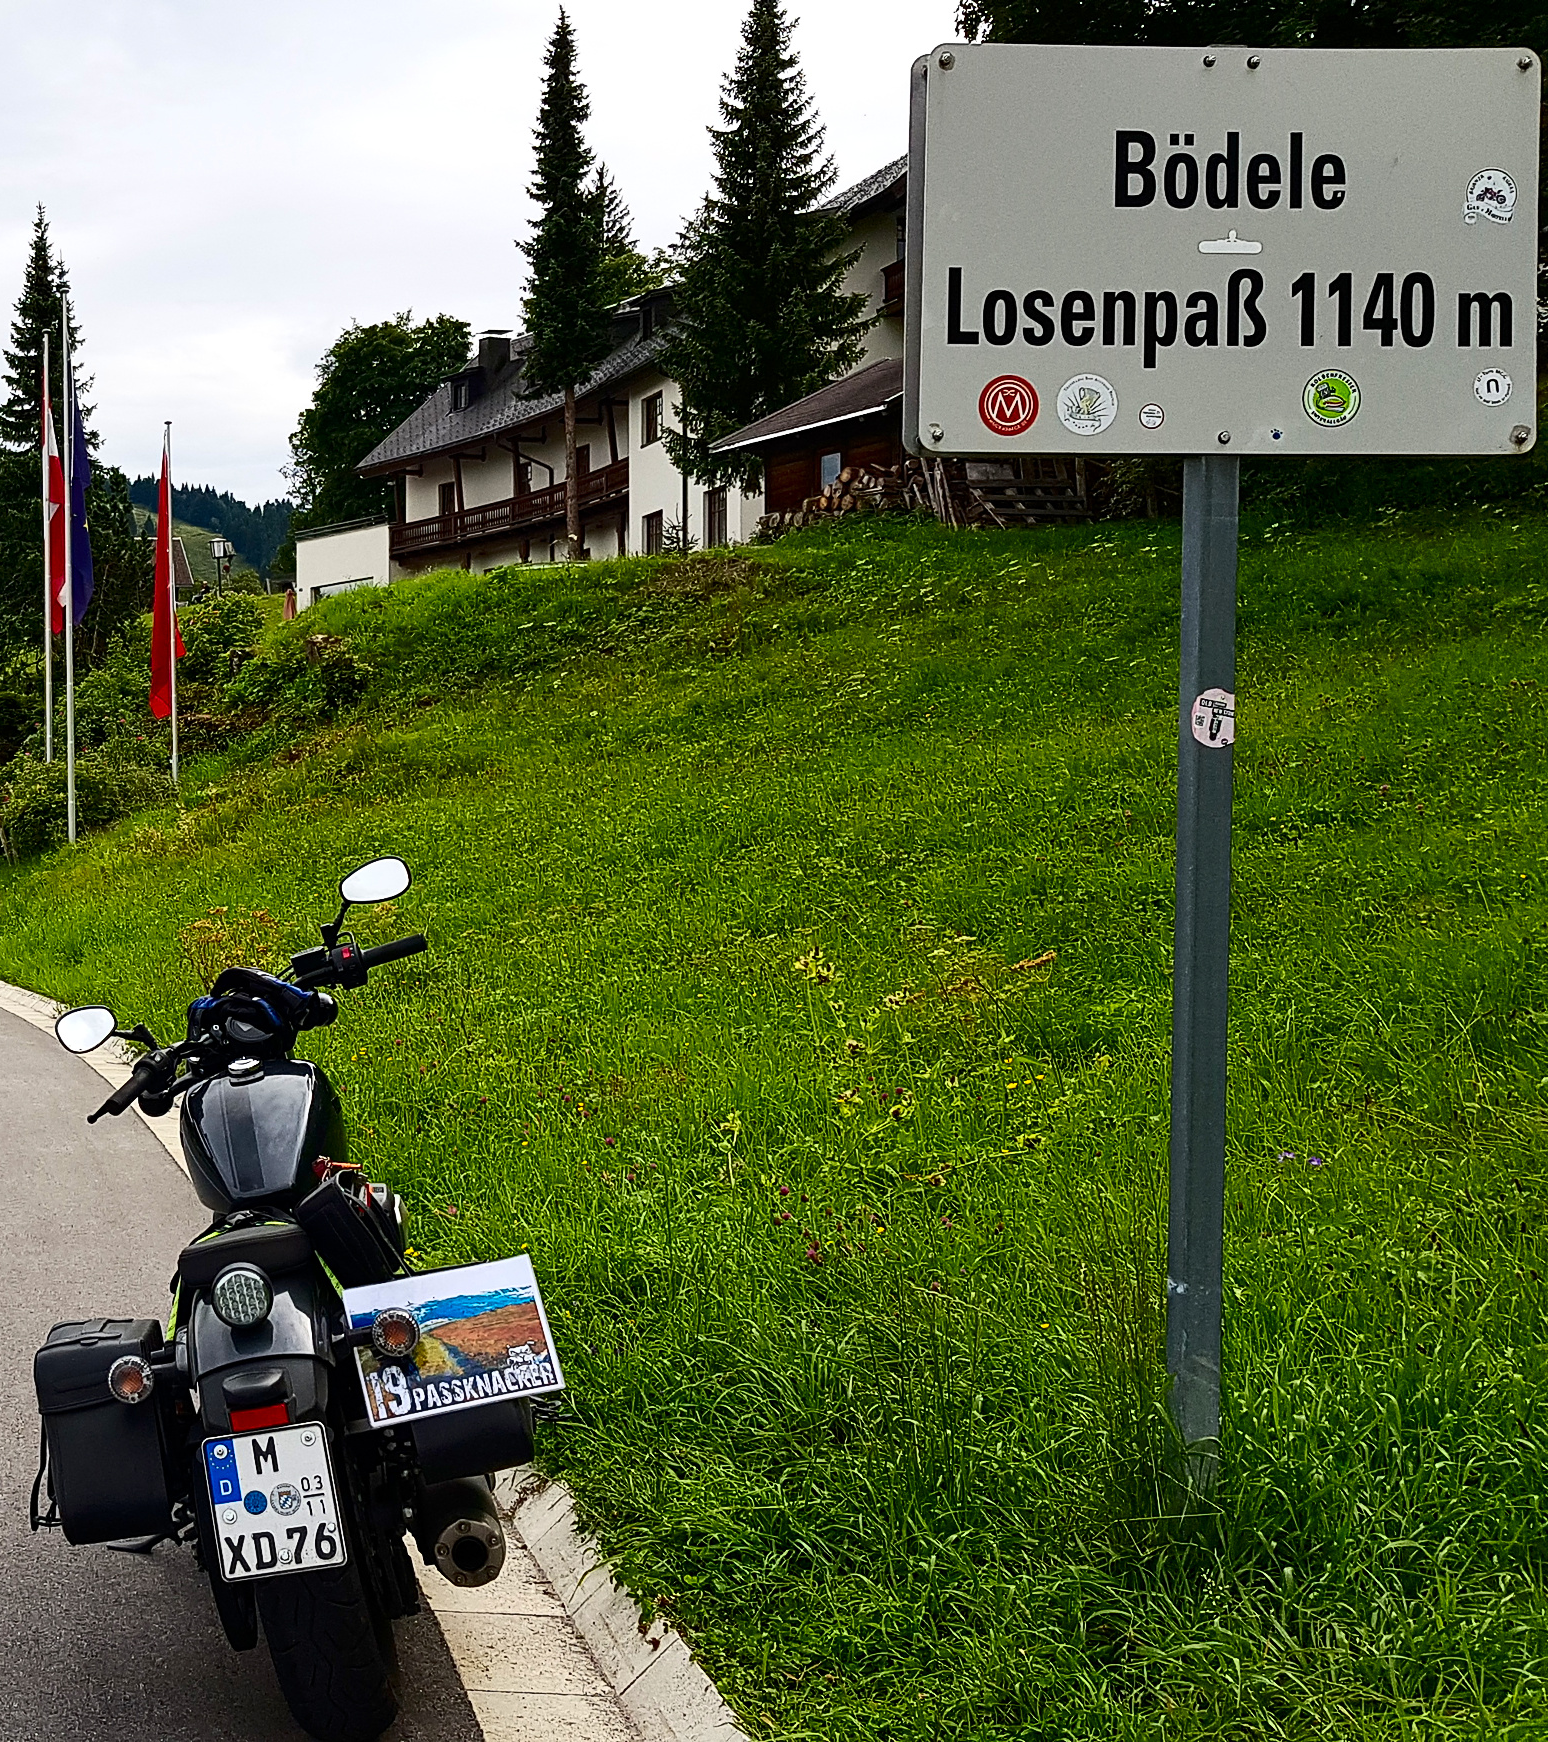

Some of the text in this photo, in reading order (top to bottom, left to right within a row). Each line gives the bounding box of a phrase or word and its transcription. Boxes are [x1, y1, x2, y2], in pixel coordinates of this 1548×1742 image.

[1113, 129, 1347, 211] Bödele
[946, 266, 1514, 369] Losenpaß 1140 m
[365, 1362, 557, 1420] 19 PASSKNACKER
[251, 1436, 280, 1475] M
[219, 1479, 233, 1496] D
[300, 1474, 324, 1492] 03
[306, 1499, 327, 1516] 11
[224, 1522, 337, 1575] XD 76
